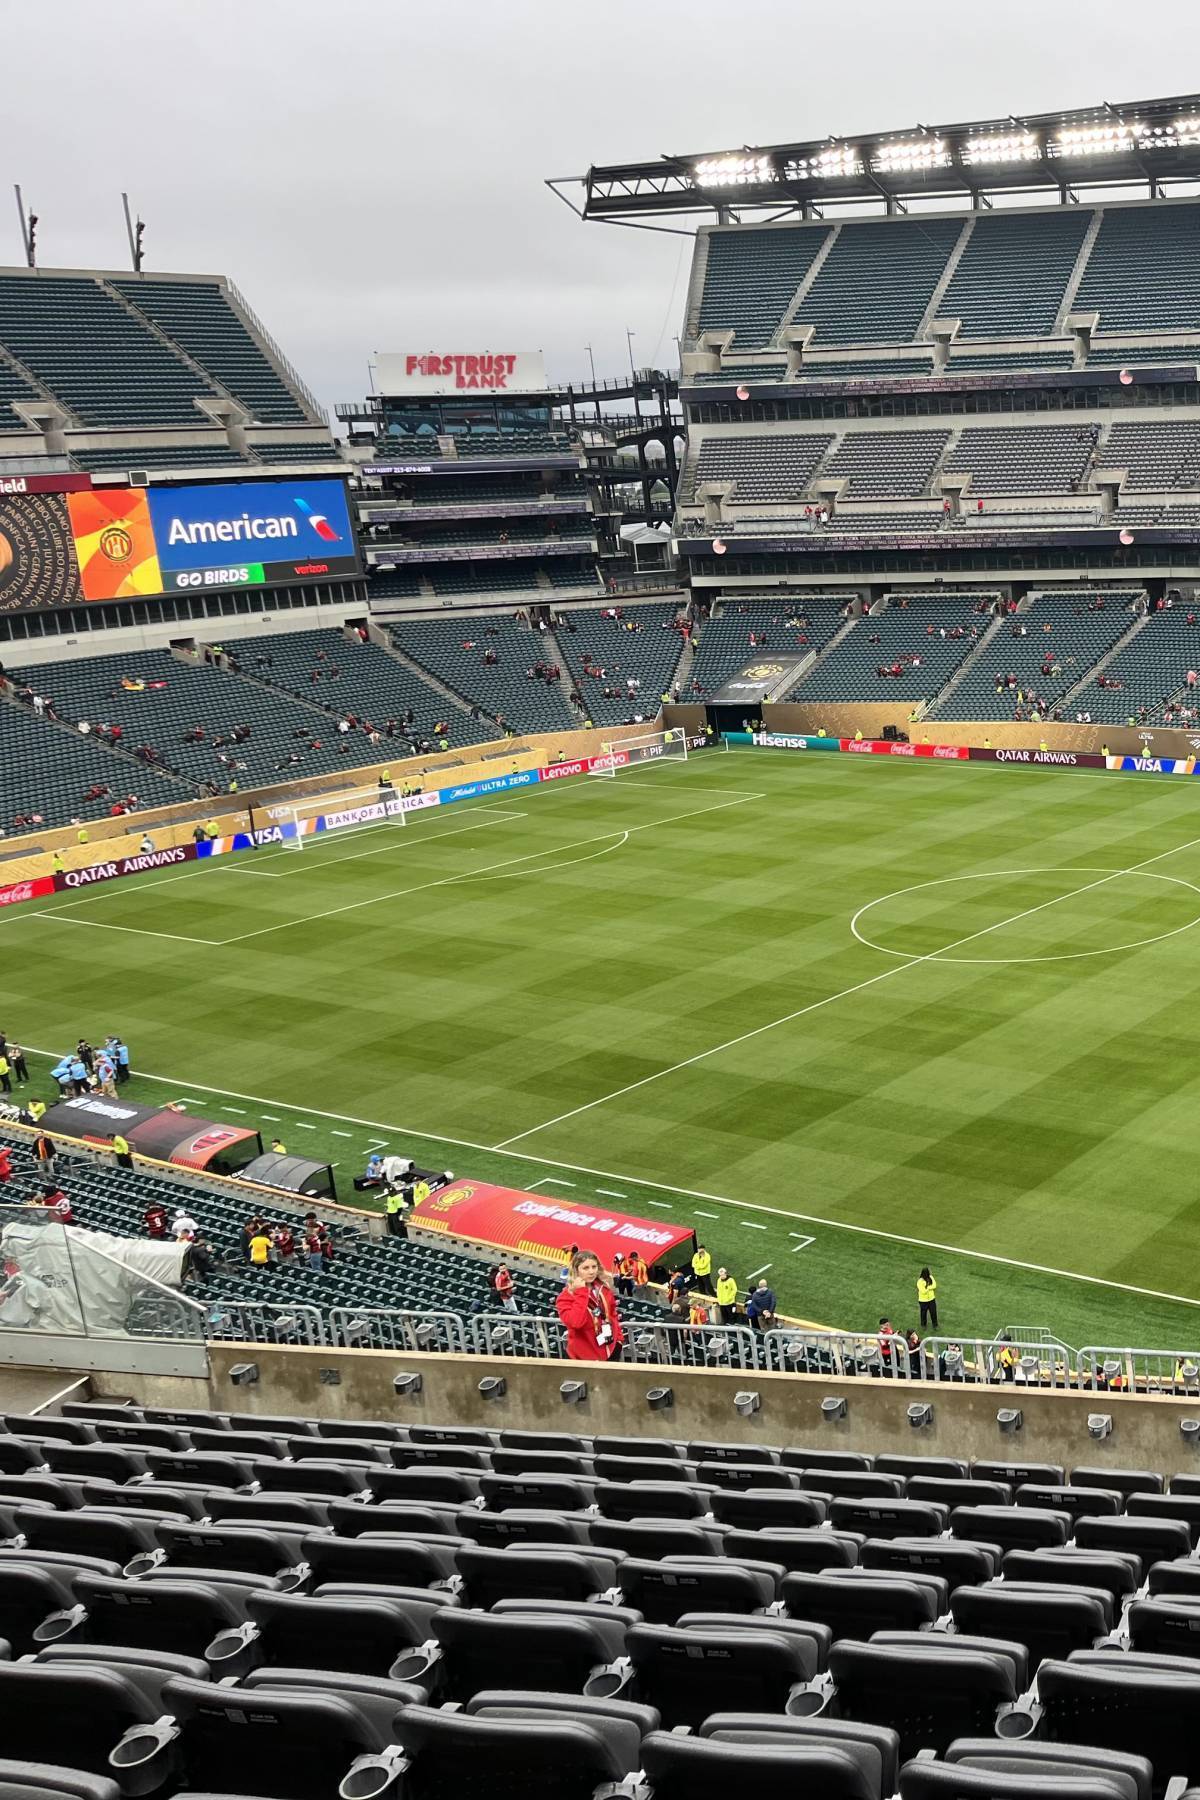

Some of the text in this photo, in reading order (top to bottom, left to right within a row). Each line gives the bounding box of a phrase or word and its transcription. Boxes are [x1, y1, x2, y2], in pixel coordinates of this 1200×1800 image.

[455, 375, 507, 389] BANK
[168, 513, 298, 545] American
[176, 567, 249, 587] GO BIRDS
[293, 563, 328, 575] verizon
[693, 737, 707, 748] PIF
[752, 733, 807, 749] Hisense
[650, 745, 664, 756] PIF
[995, 749, 1077, 765] QATAR AIRWAYS
[588, 753, 626, 770] Lenovo
[1132, 758, 1164, 772] VISA
[541, 762, 582, 780] Lenovo
[481, 779, 507, 791] ULTRA
[509, 774, 530, 786] ZERO
[327, 812, 358, 826] BANK
[360, 808, 375, 818] OF
[243, 826, 284, 847] VISA
[64, 847, 186, 887] QATAR AIRWAYS
[592, 1214, 618, 1232] de
[613, 1216, 673, 1246] Tunisie
